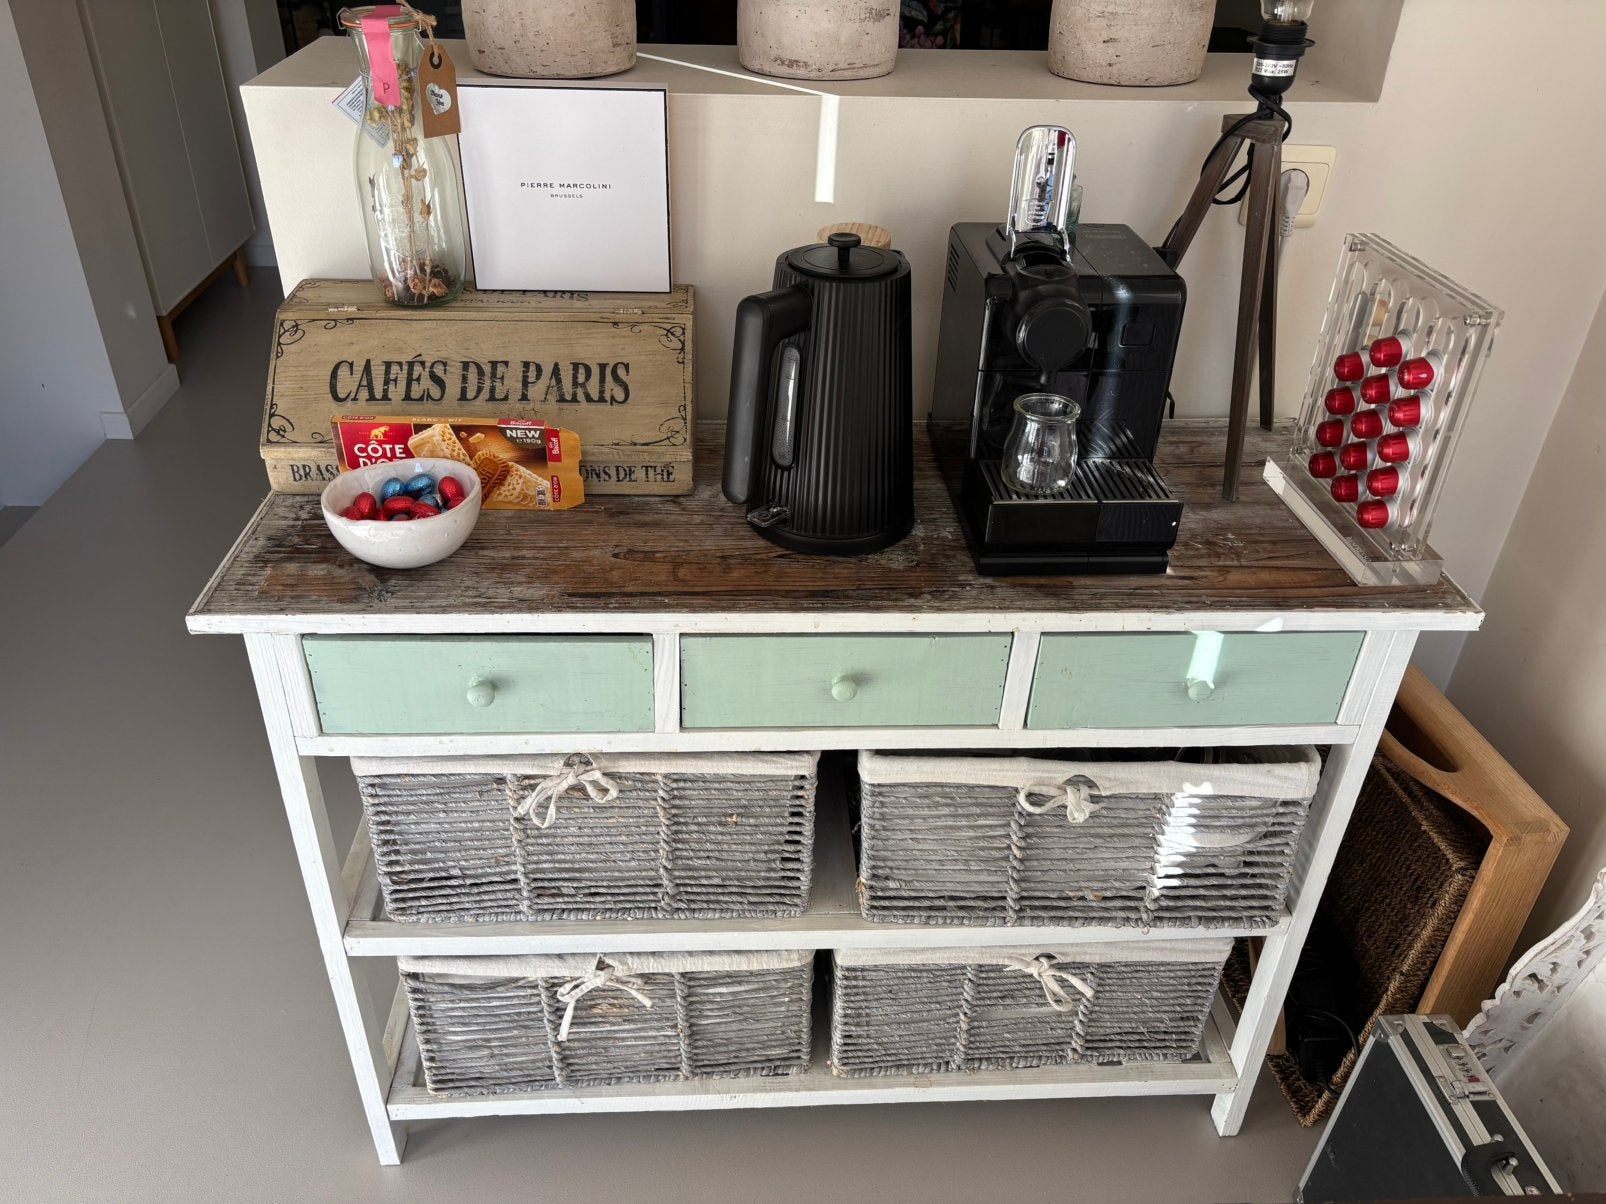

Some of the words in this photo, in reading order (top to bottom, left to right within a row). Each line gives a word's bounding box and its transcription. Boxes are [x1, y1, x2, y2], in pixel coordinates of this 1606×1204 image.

[382, 82, 390, 95] P
[329, 353, 448, 404] CAFÉS
[456, 360, 509, 402] DE
[517, 360, 630, 406] PARIS
[506, 429, 540, 438] NEW
[354, 440, 406, 457] CÔTE
[614, 465, 638, 482] DE
